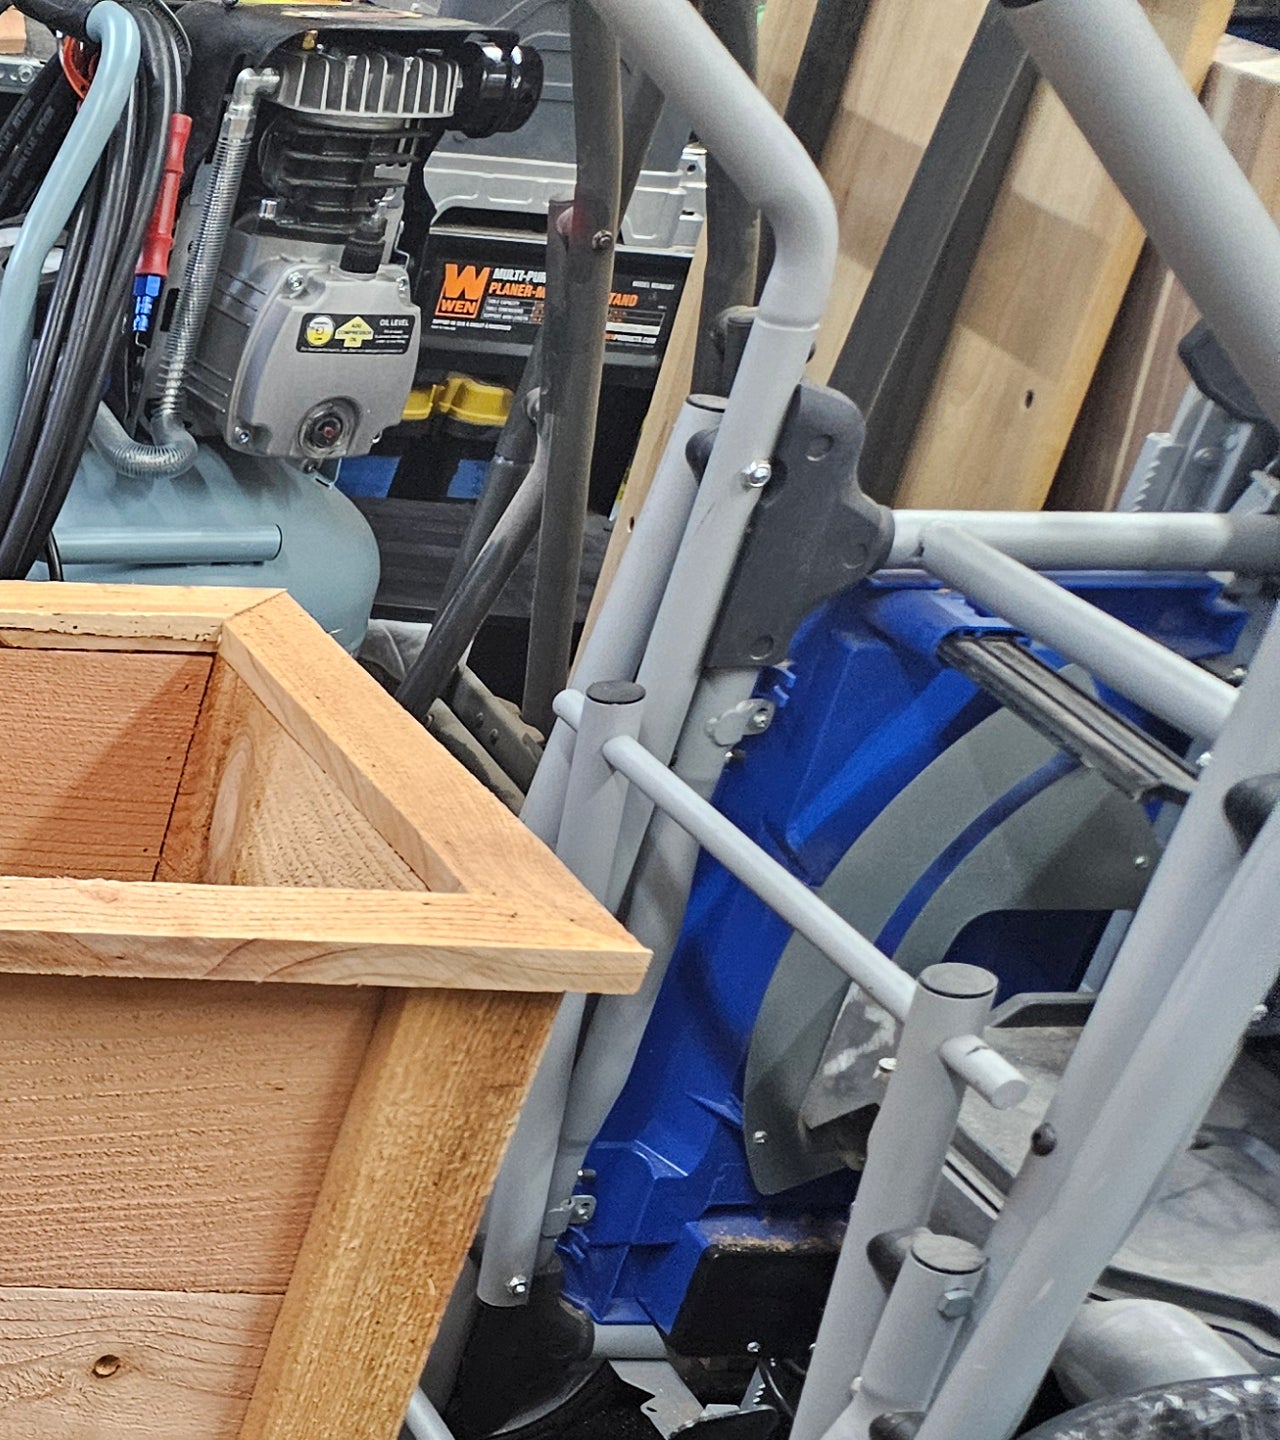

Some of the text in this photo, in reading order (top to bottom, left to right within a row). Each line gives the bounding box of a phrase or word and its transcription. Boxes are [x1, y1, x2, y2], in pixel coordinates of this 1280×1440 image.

[492, 267, 547, 284] MULTI-PUR
[488, 282, 546, 299] PLANER-M
[440, 299, 477, 314] WEN
[608, 292, 639, 307] TAND
